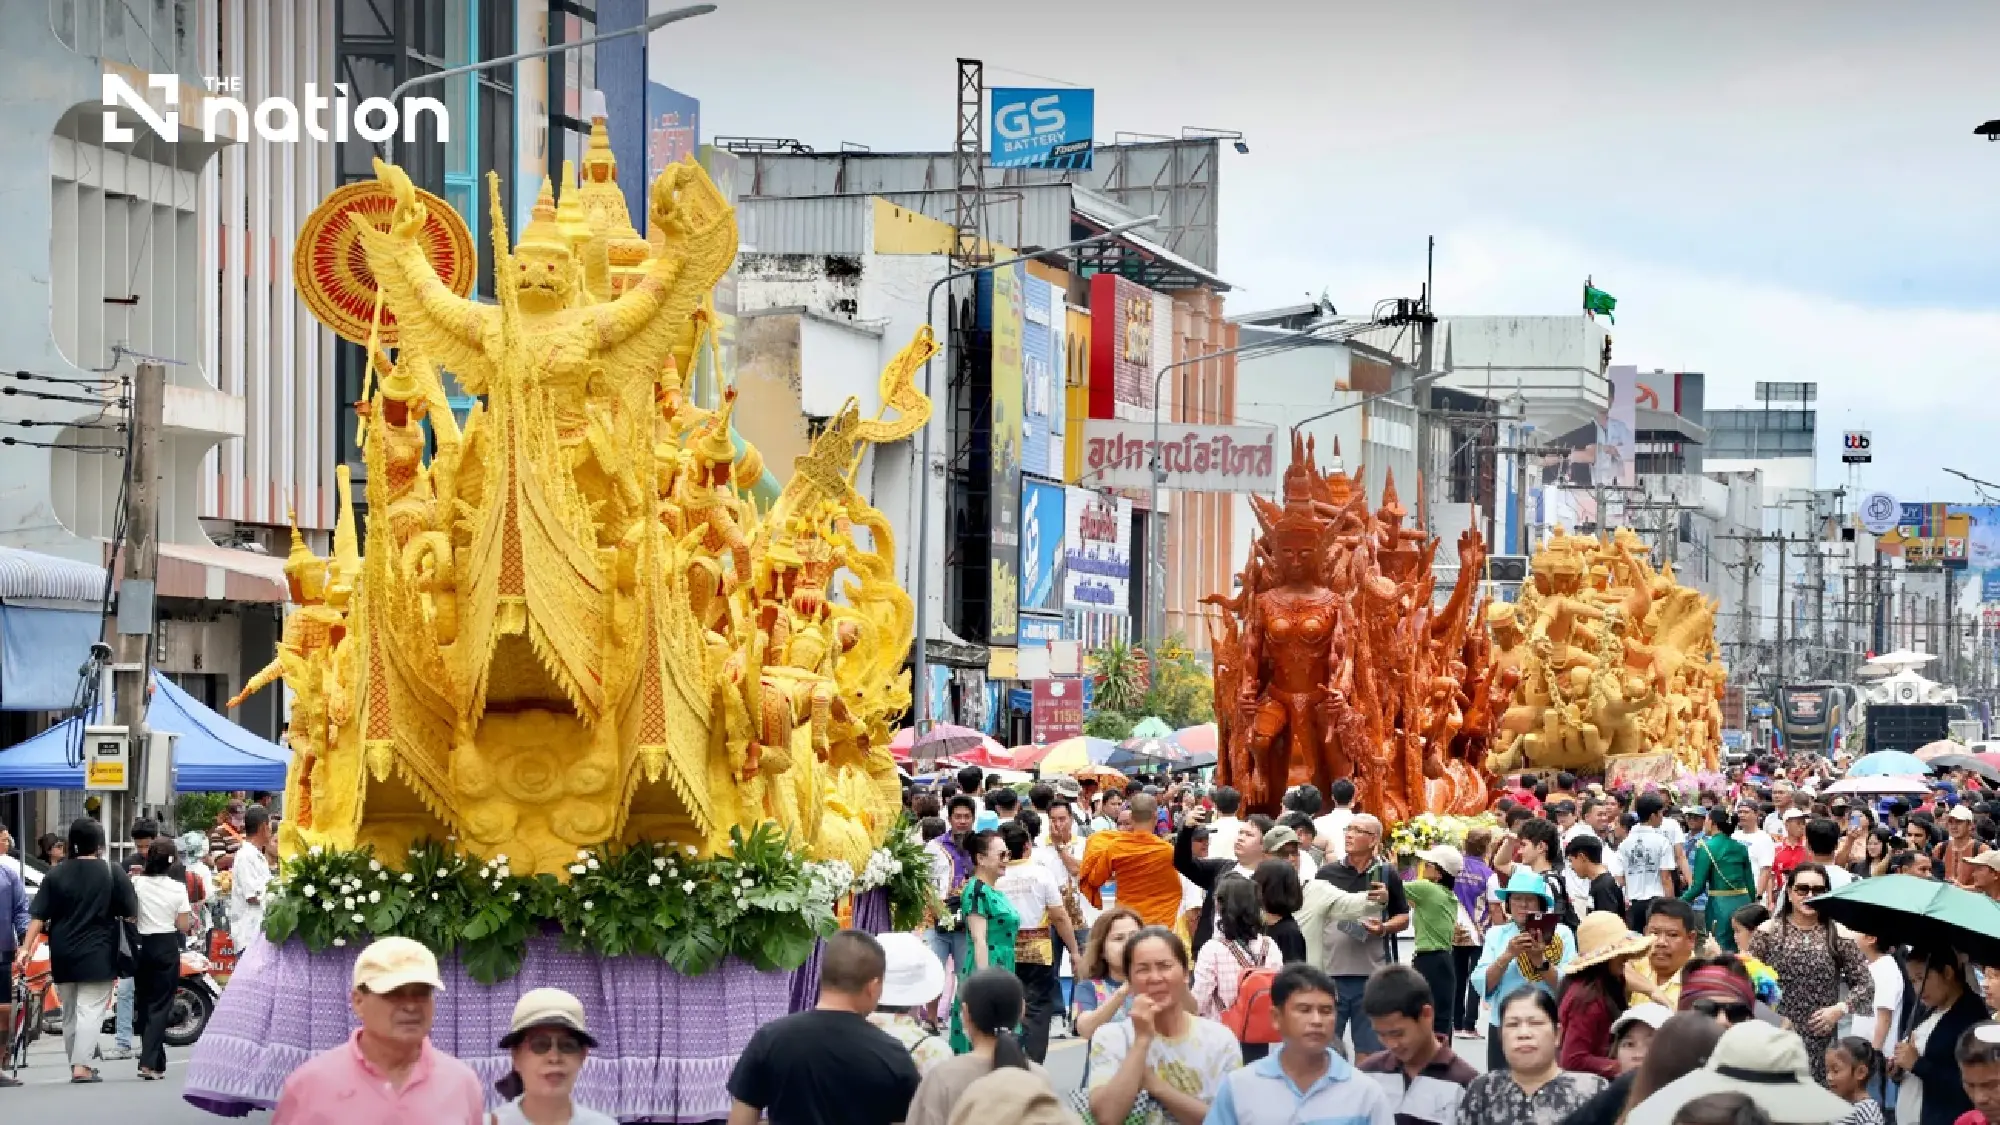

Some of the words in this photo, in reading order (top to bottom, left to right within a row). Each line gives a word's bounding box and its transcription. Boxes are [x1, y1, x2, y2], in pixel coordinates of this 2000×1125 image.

[995, 94, 1066, 140] GS
[1003, 131, 1066, 152] BATTERY
[1844, 433, 1870, 449] ttb
